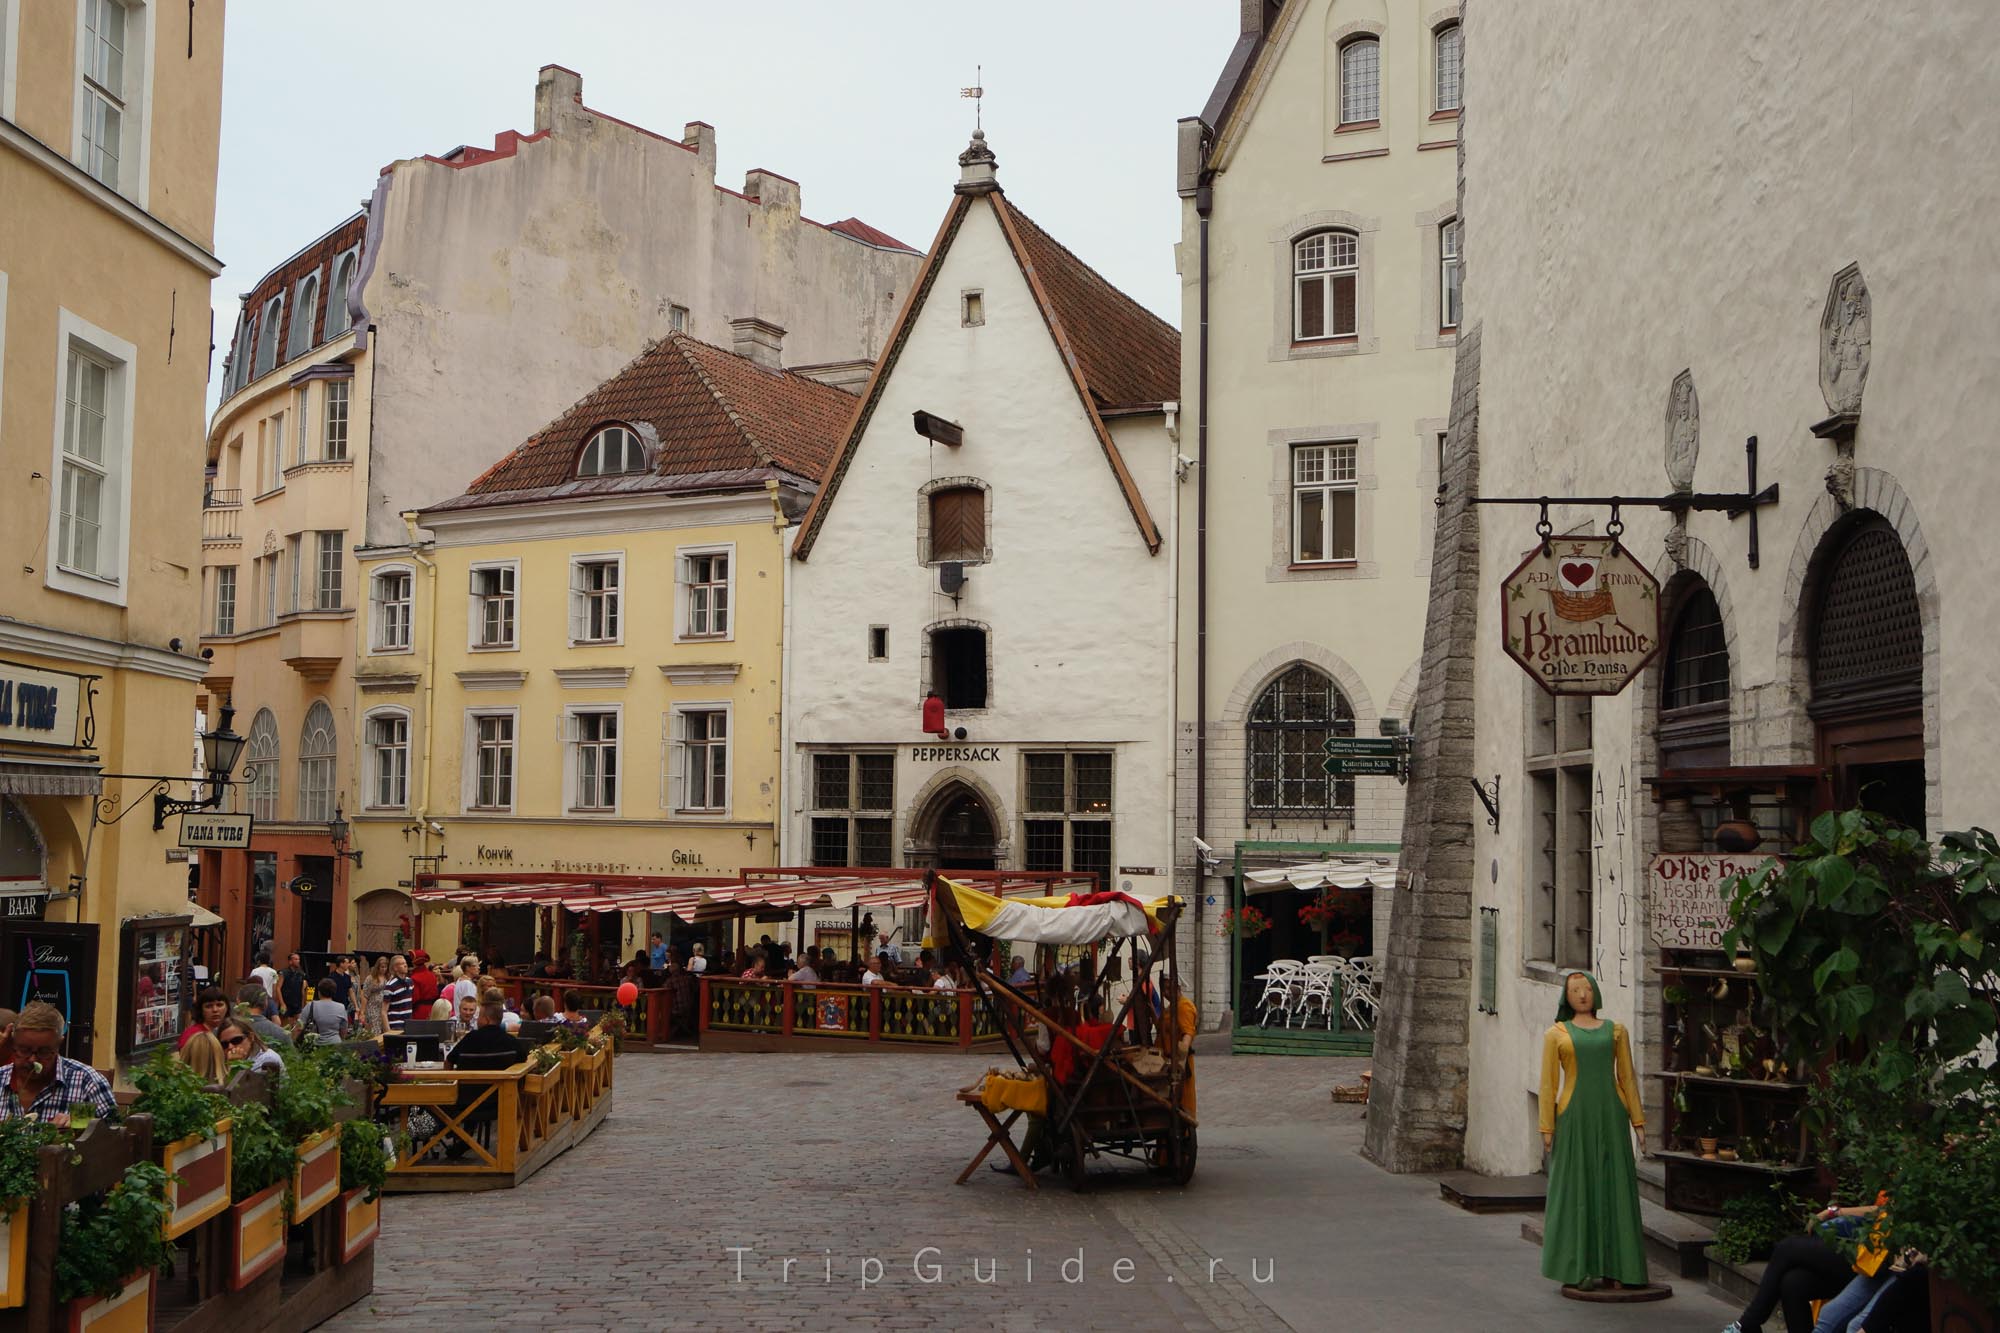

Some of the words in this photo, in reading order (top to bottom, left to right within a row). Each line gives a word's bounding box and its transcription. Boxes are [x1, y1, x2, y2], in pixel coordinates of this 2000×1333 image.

[1520, 610, 1649, 662] Krambude
[1541, 659, 1578, 675] Olde
[912, 747, 1001, 762] PEPPERSACK
[1342, 760, 1373, 768] Katariina
[187, 825, 214, 841] VANA
[217, 826, 244, 842] TURG
[1594, 770, 1605, 983] ANTIIK
[1616, 764, 1628, 989] ANTIQUE
[1656, 857, 1712, 883] Olde
[8, 897, 36, 916] BAAR
[1678, 928, 1722, 946] SHO
[34, 945, 71, 963] Baar
